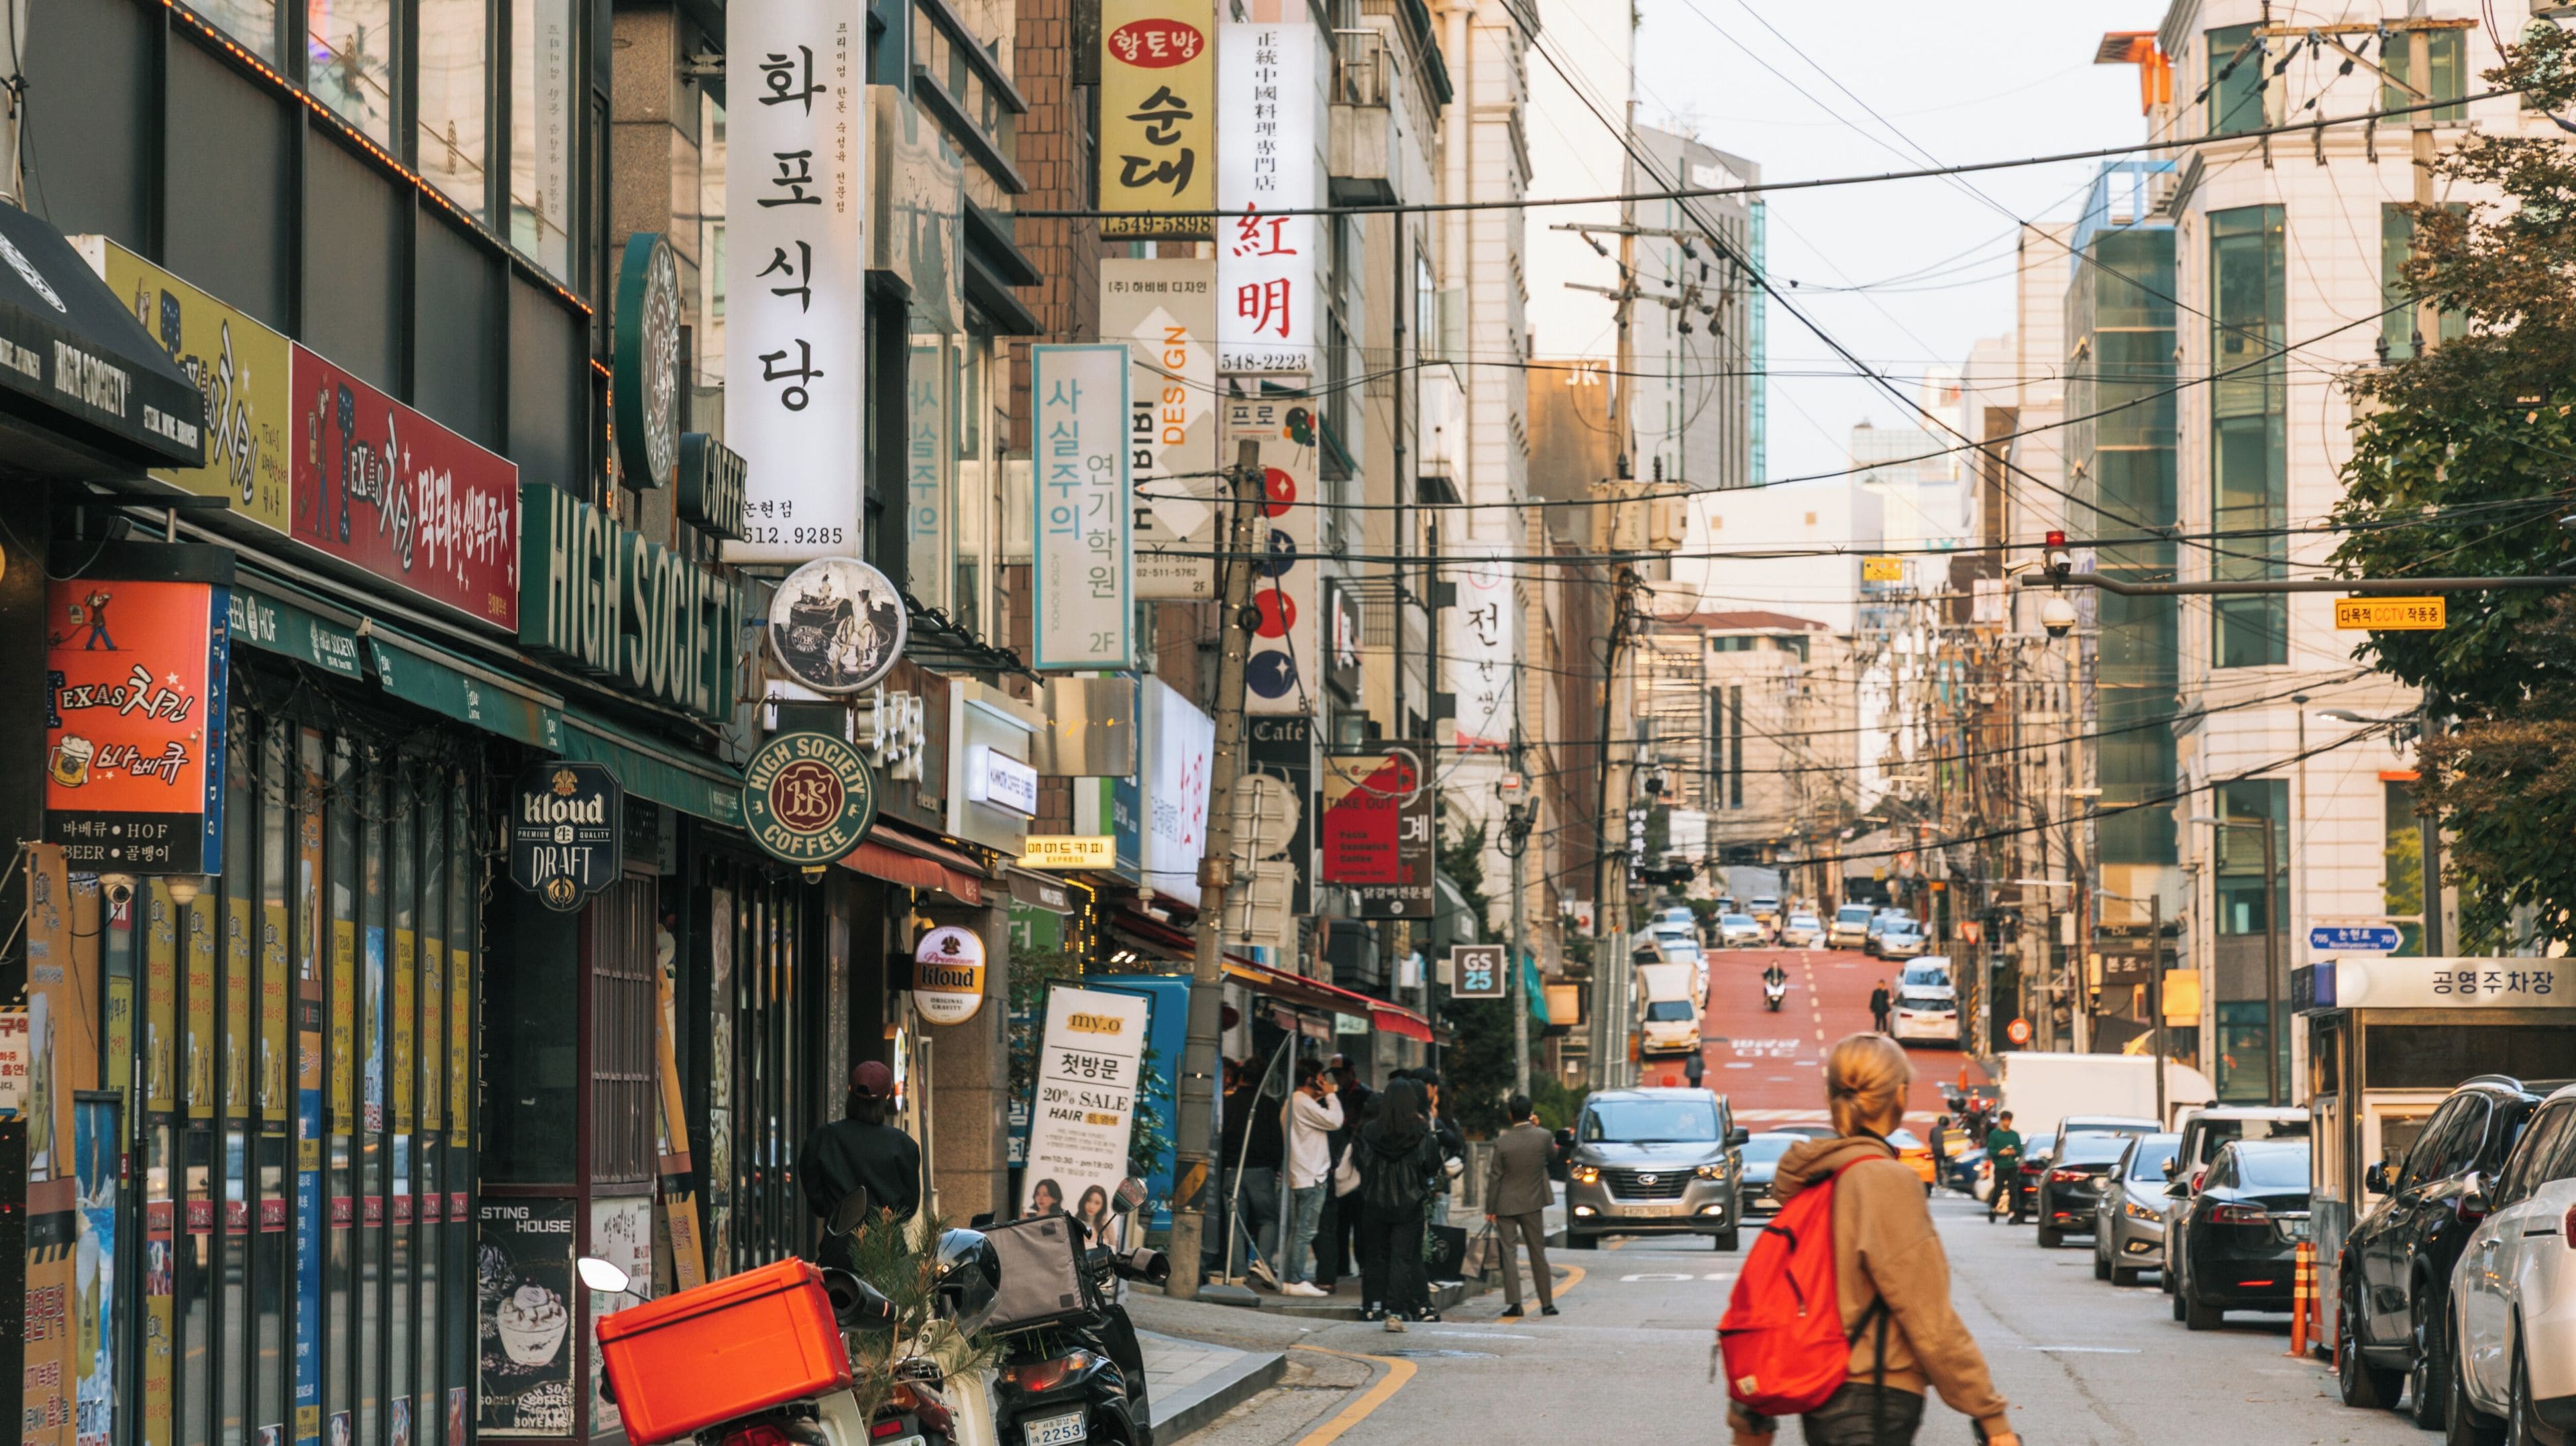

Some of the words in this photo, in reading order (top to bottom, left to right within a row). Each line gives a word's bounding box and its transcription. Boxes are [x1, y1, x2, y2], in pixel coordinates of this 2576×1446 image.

[836, 22, 847, 78] 프리미엄
[1114, 29, 1199, 61] 황토방
[836, 86, 847, 113] 한돈
[1254, 30, 1279, 192] 正統中國料理專門店
[835, 121, 847, 163] 숙성육
[1119, 85, 1195, 198] 순대
[835, 172, 846, 213] 전문점
[755, 44, 827, 412] 화포식당
[1232, 201, 1298, 339] 紅明
[1132, 281, 1168, 294] 하비비
[1173, 281, 1208, 294] 디자인
[1221, 353, 1307, 370] 548-2223
[83, 353, 125, 418] SOCIETY
[1163, 326, 1186, 445] DESIGN
[1232, 406, 1275, 425] 프로
[1046, 378, 1082, 541] 사실주의
[743, 499, 793, 518] 논현점
[743, 526, 843, 545] 512.9285
[1085, 453, 1117, 600] 연기학원
[1051, 554, 1060, 587] ACTOR
[1193, 581, 1206, 592] 2F
[549, 483, 621, 677] HIGH
[628, 529, 743, 723] SOCIETY
[1051, 590, 1060, 633] SCHOOL
[2341, 608, 2371, 623] 다목적
[2374, 608, 2405, 622] CCTV
[2408, 607, 2438, 622] 작동중
[258, 606, 276, 643] HOF
[1466, 602, 1498, 647] 전
[1089, 632, 1116, 653] 2F
[119, 663, 194, 722] 치킨
[1254, 718, 1305, 742] Café
[95, 740, 191, 785] 바베큐
[749, 743, 792, 791] HIGH
[796, 737, 866, 794] SOCIETY
[523, 792, 605, 825] Kloud
[1327, 797, 1360, 810] TAKE
[1365, 797, 1392, 810] OUT
[62, 821, 107, 838] 바베큐
[127, 823, 168, 838] HOF
[517, 830, 549, 838] PREMIUM
[579, 831, 609, 839] QUALITY
[763, 824, 847, 856] COFFEE
[125, 845, 169, 863] 골뱅이
[533, 846, 593, 888] DRAFT
[1463, 952, 1493, 971] GS
[922, 965, 975, 987] Kloud
[1464, 971, 1493, 991] 25
[2433, 970, 2554, 995] 공영주차장
[930, 997, 963, 1005] ORIGINAL
[1071, 1013, 1120, 1034] my.o
[1061, 1052, 1119, 1080] 첫방문
[1042, 1087, 1075, 1105] 20%
[1079, 1091, 1128, 1112] SALE
[1049, 1107, 1083, 1123] HAIR
[516, 1220, 571, 1233] HOUSE
[1042, 1423, 1081, 1443] 2253
